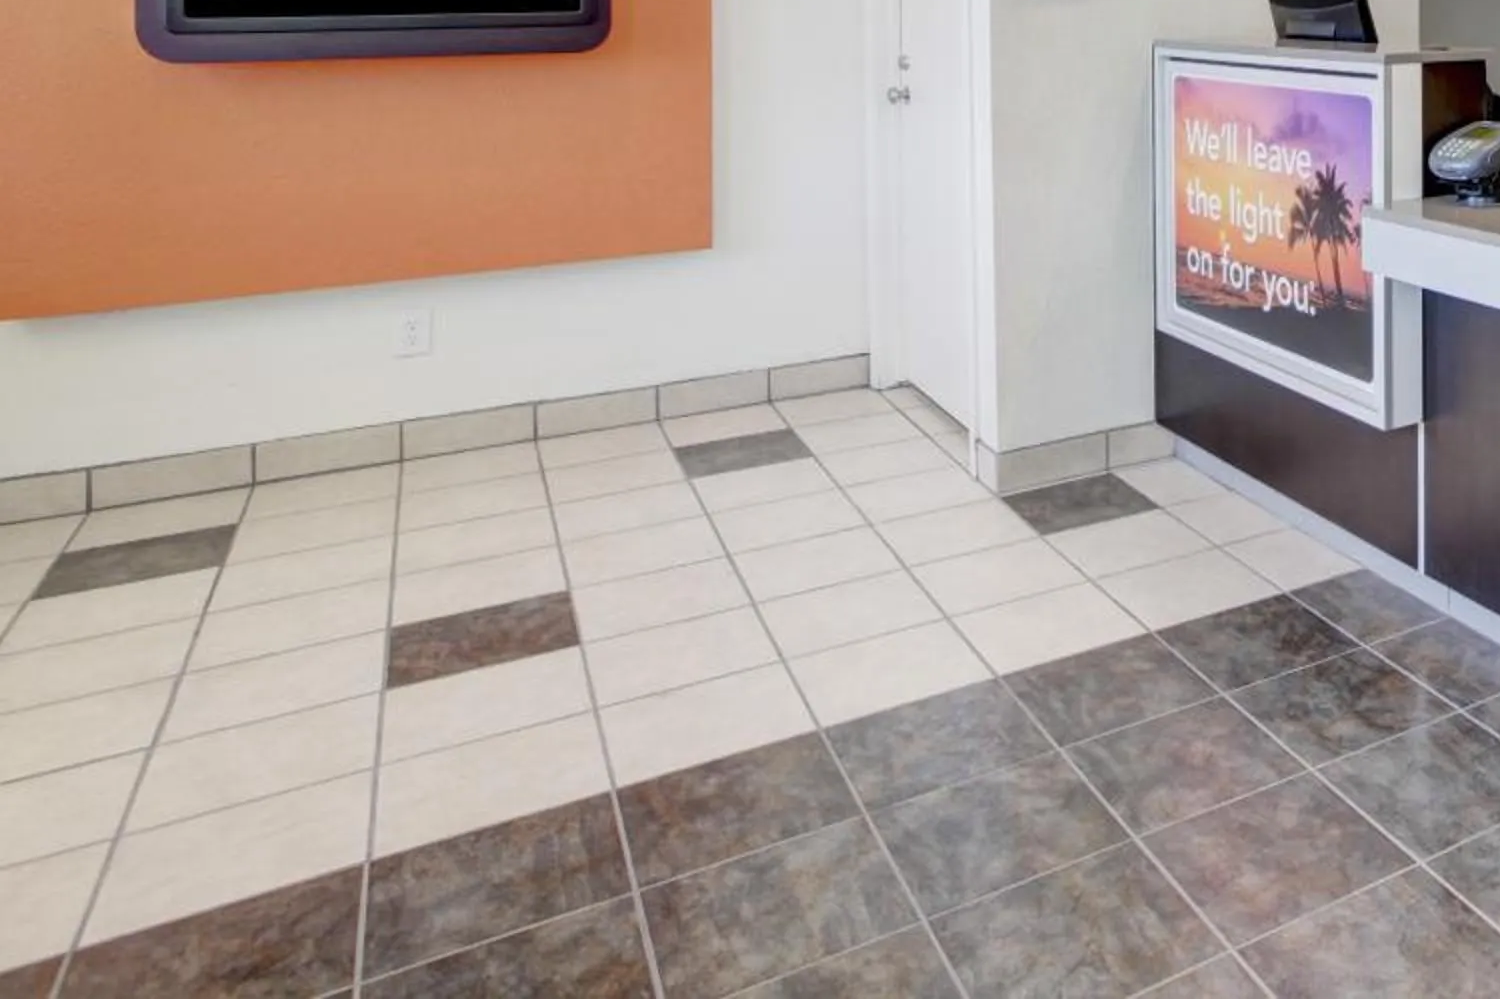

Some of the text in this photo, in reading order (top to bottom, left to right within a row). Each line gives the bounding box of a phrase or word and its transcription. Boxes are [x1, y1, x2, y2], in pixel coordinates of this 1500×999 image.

[1185, 118, 1313, 179] We'll leave
[1186, 178, 1285, 243] the light
[1187, 247, 1214, 279] on
[1220, 242, 1255, 292] for
